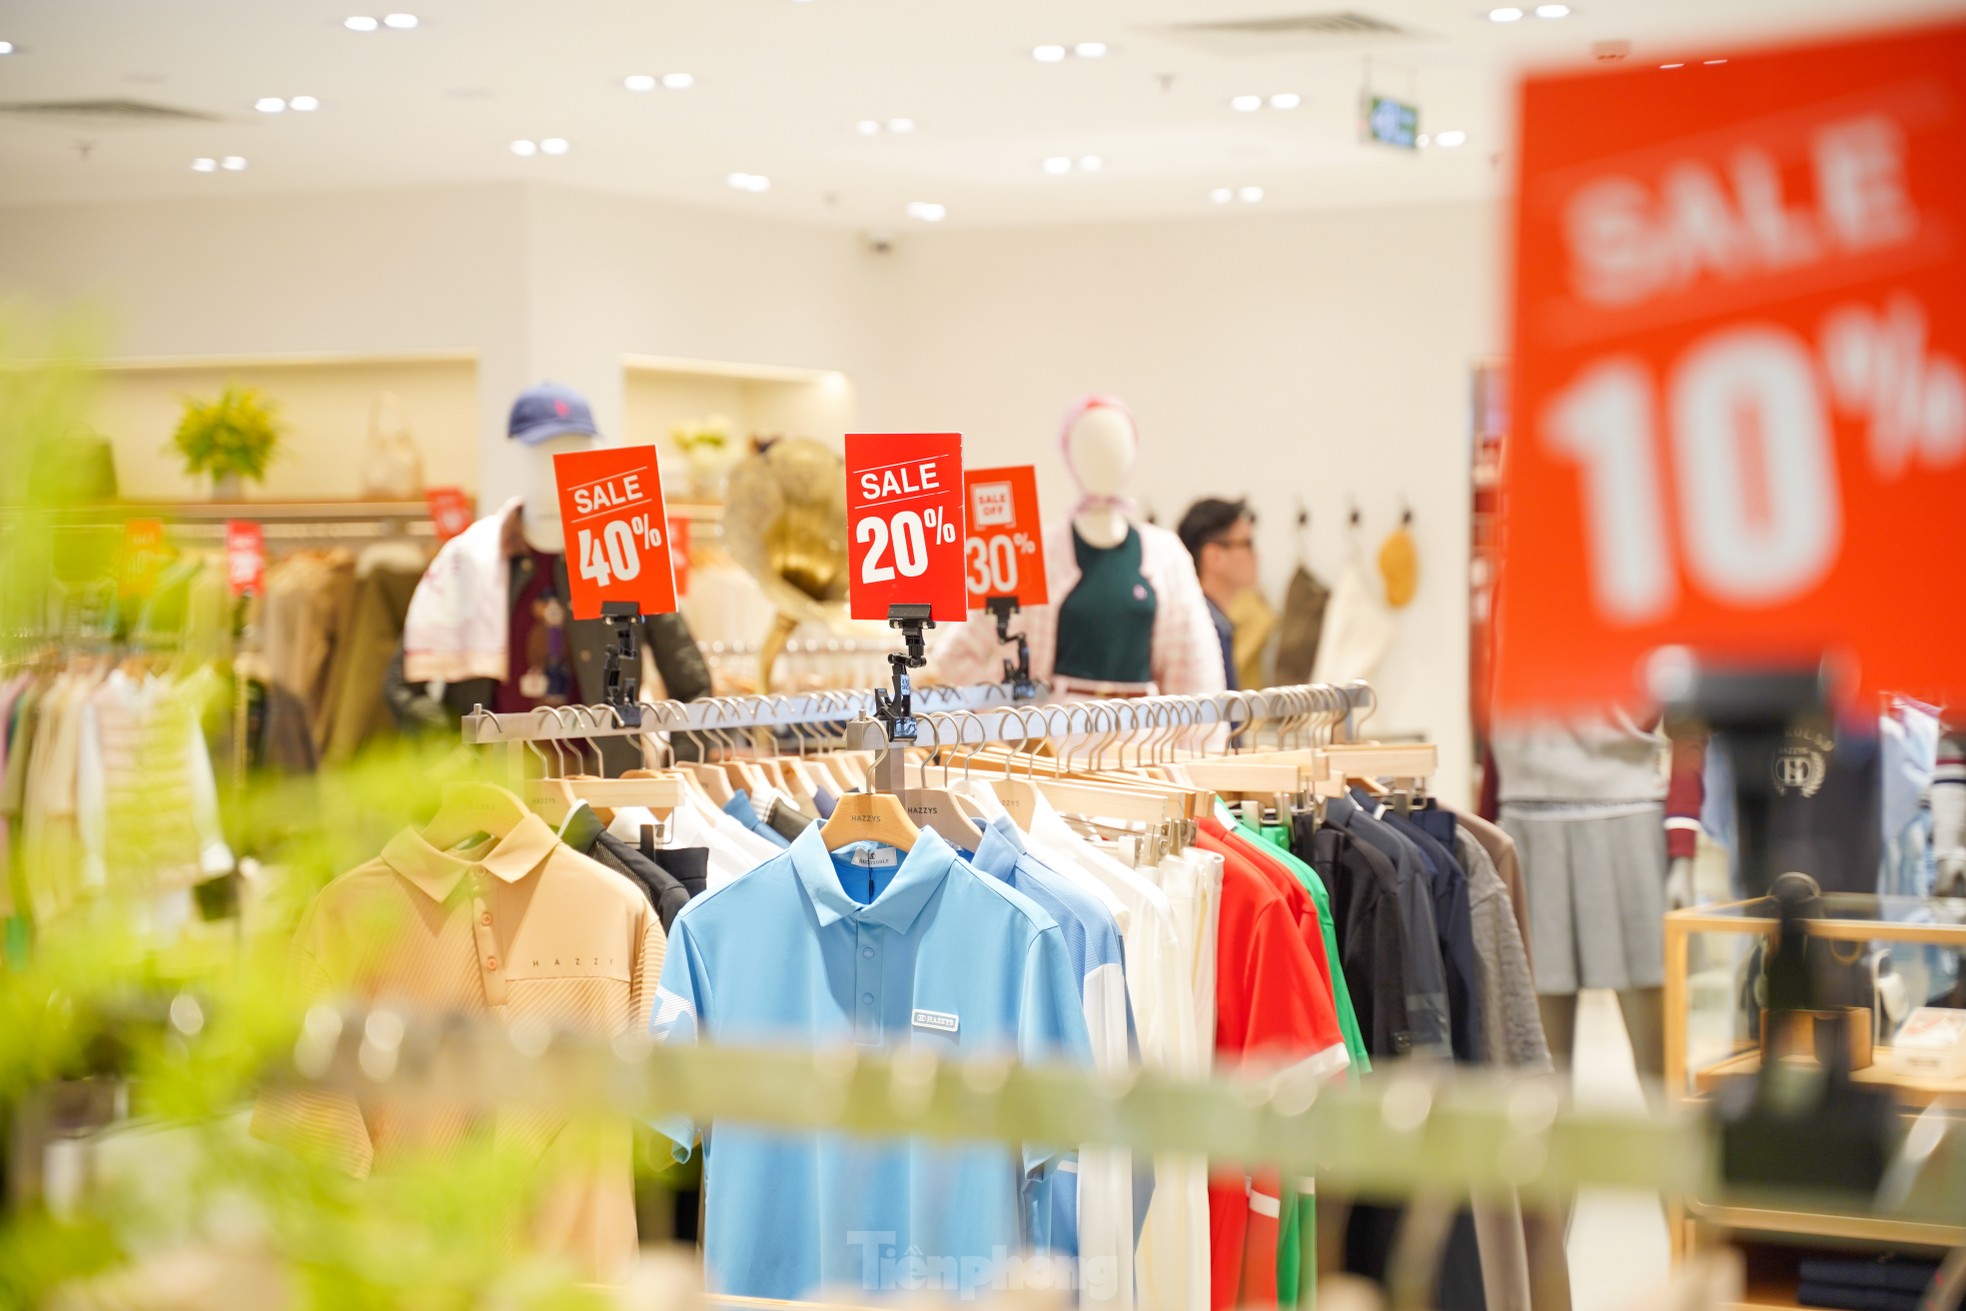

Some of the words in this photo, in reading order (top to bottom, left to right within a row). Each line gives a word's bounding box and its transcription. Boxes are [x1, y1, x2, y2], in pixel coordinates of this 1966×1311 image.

[1563, 112, 1918, 308] SALE
[1535, 292, 1966, 627] 10%
[574, 474, 643, 514] SALE
[861, 462, 940, 500] SALE
[978, 493, 1006, 505] SALE
[981, 506, 1004, 517] OFF
[578, 513, 662, 588] 40%
[856, 505, 956, 585] 20%
[965, 532, 1036, 595] 30%
[907, 807, 938, 815] HAZZYS
[927, 1015, 954, 1027] HAZZYS
